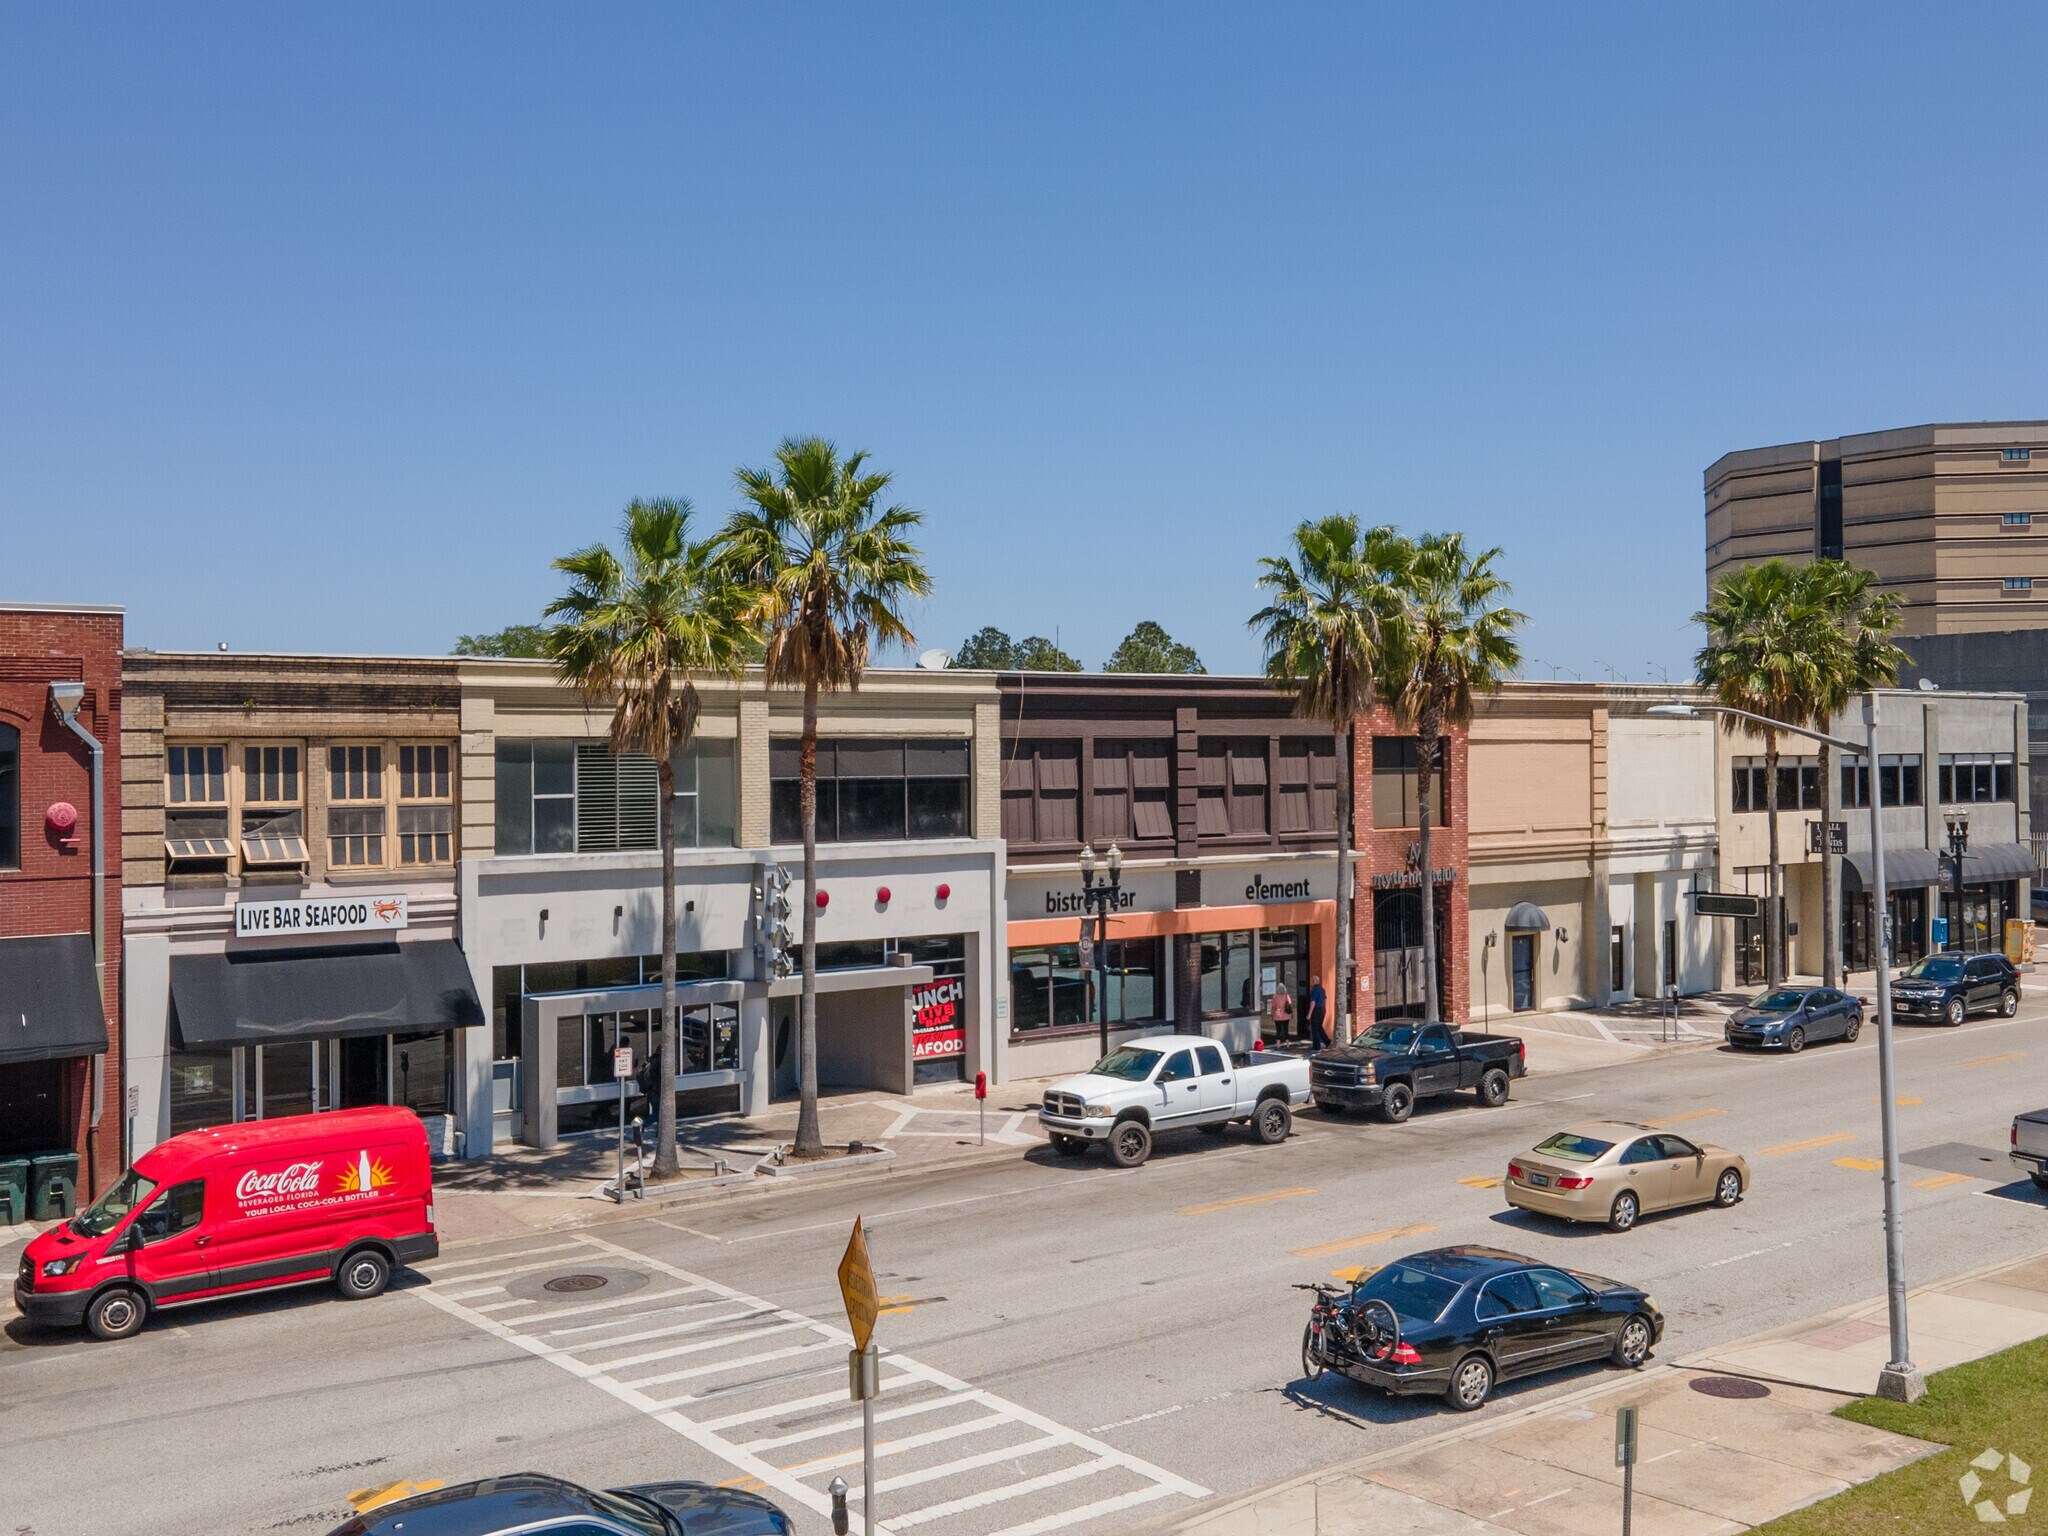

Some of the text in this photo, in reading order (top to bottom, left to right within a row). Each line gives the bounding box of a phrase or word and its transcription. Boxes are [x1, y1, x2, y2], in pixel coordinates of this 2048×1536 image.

[1245, 874, 1310, 900] element
[1046, 890, 1089, 913] bistr
[241, 904, 367, 930] LIVE BAR SEAFOOD
[912, 981, 964, 1012] UNCH
[921, 1003, 953, 1022] LIVE
[912, 1039, 963, 1056] AFOOD
[236, 1160, 323, 1200] Coca-Cola
[238, 1191, 320, 1208] BEVERAGES FLORIDA
[245, 1190, 379, 1217] YOUR LOCAL COCA-COLA BOTTLER
